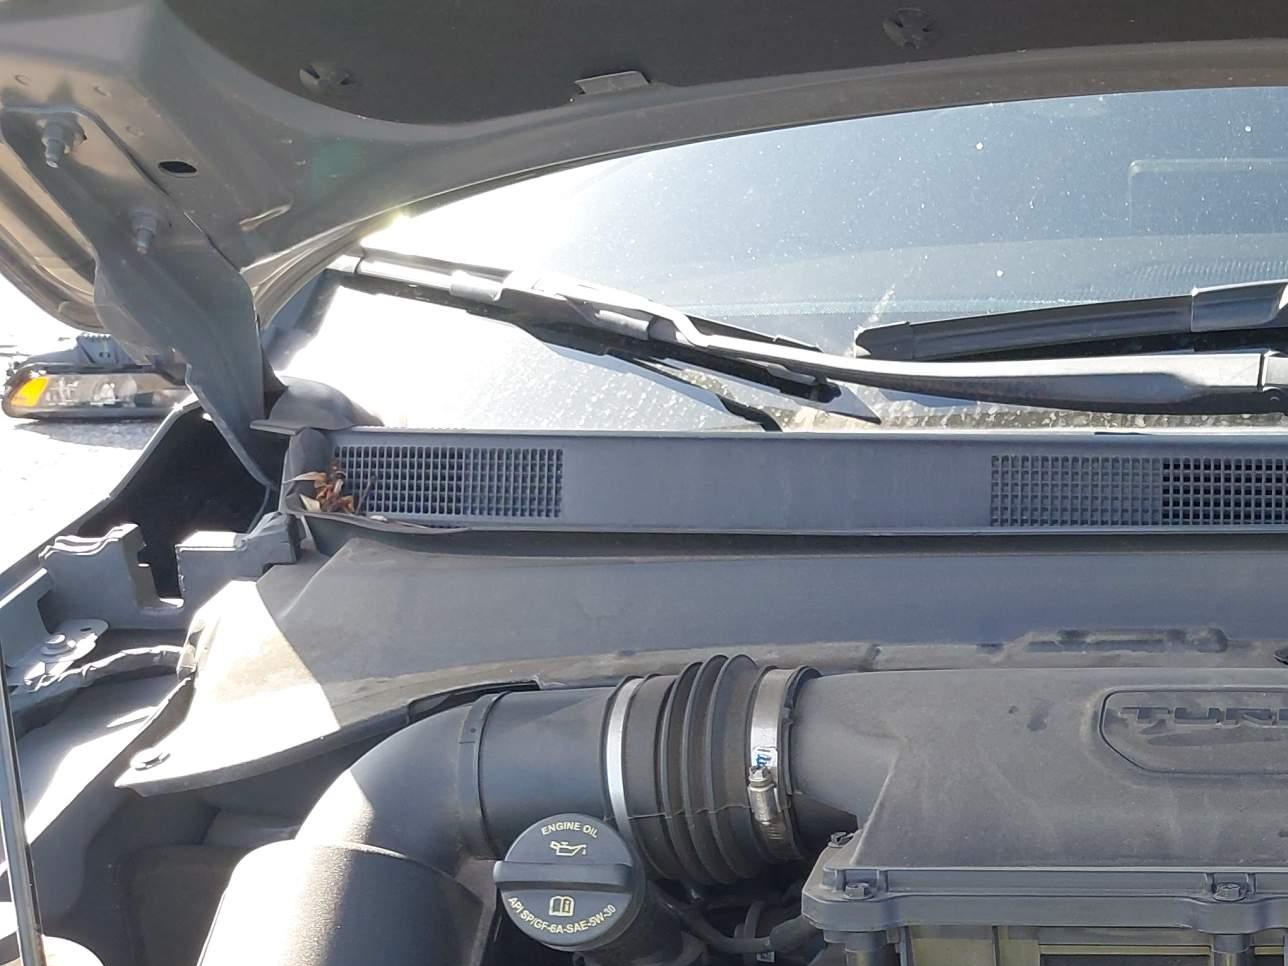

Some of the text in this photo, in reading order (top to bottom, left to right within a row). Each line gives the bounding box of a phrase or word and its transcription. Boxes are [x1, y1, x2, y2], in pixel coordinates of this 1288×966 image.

[541, 821, 599, 839] ENGINE OIL
[507, 897, 616, 934] API SP/GF-6A-SAE-5W-30
